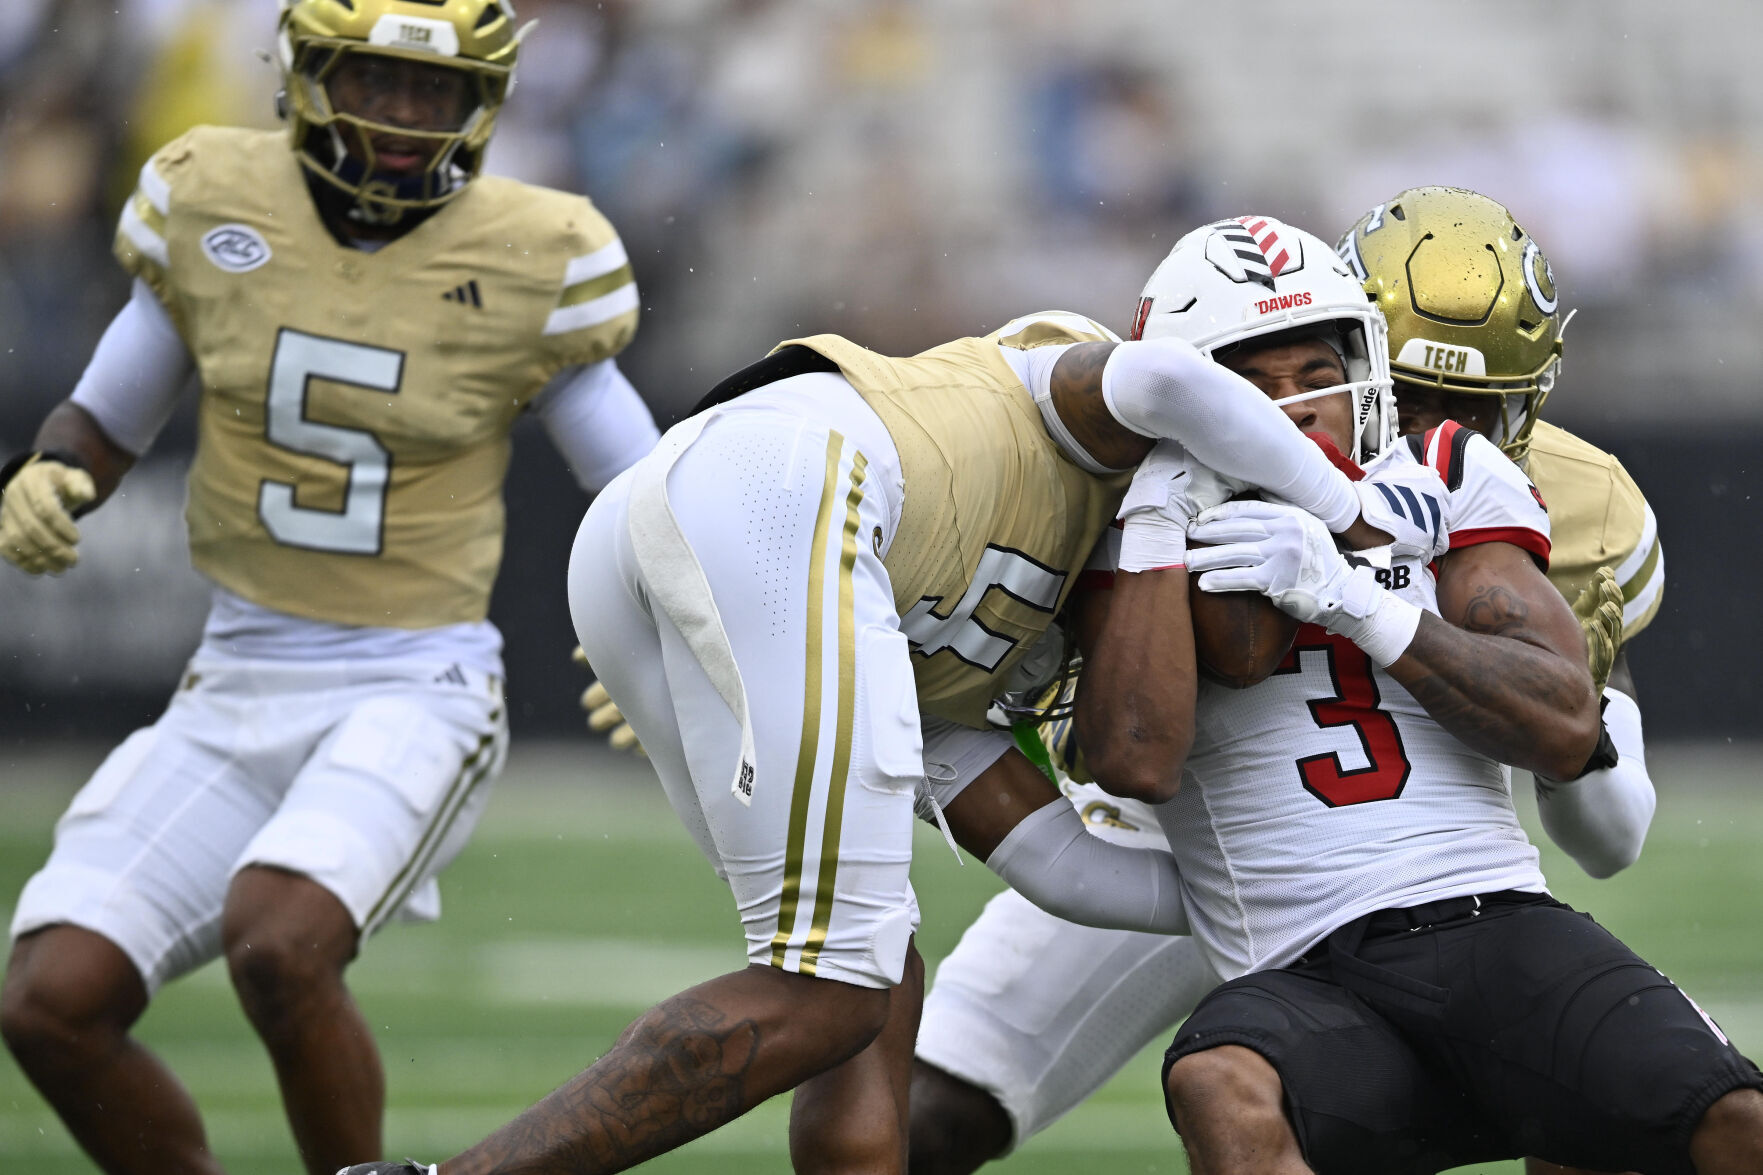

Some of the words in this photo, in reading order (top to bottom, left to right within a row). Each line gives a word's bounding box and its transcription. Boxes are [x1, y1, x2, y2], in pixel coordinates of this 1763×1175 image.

[258, 326, 406, 556] 5
[1424, 345, 1468, 373] TECH
[1271, 620, 1411, 808] 3
